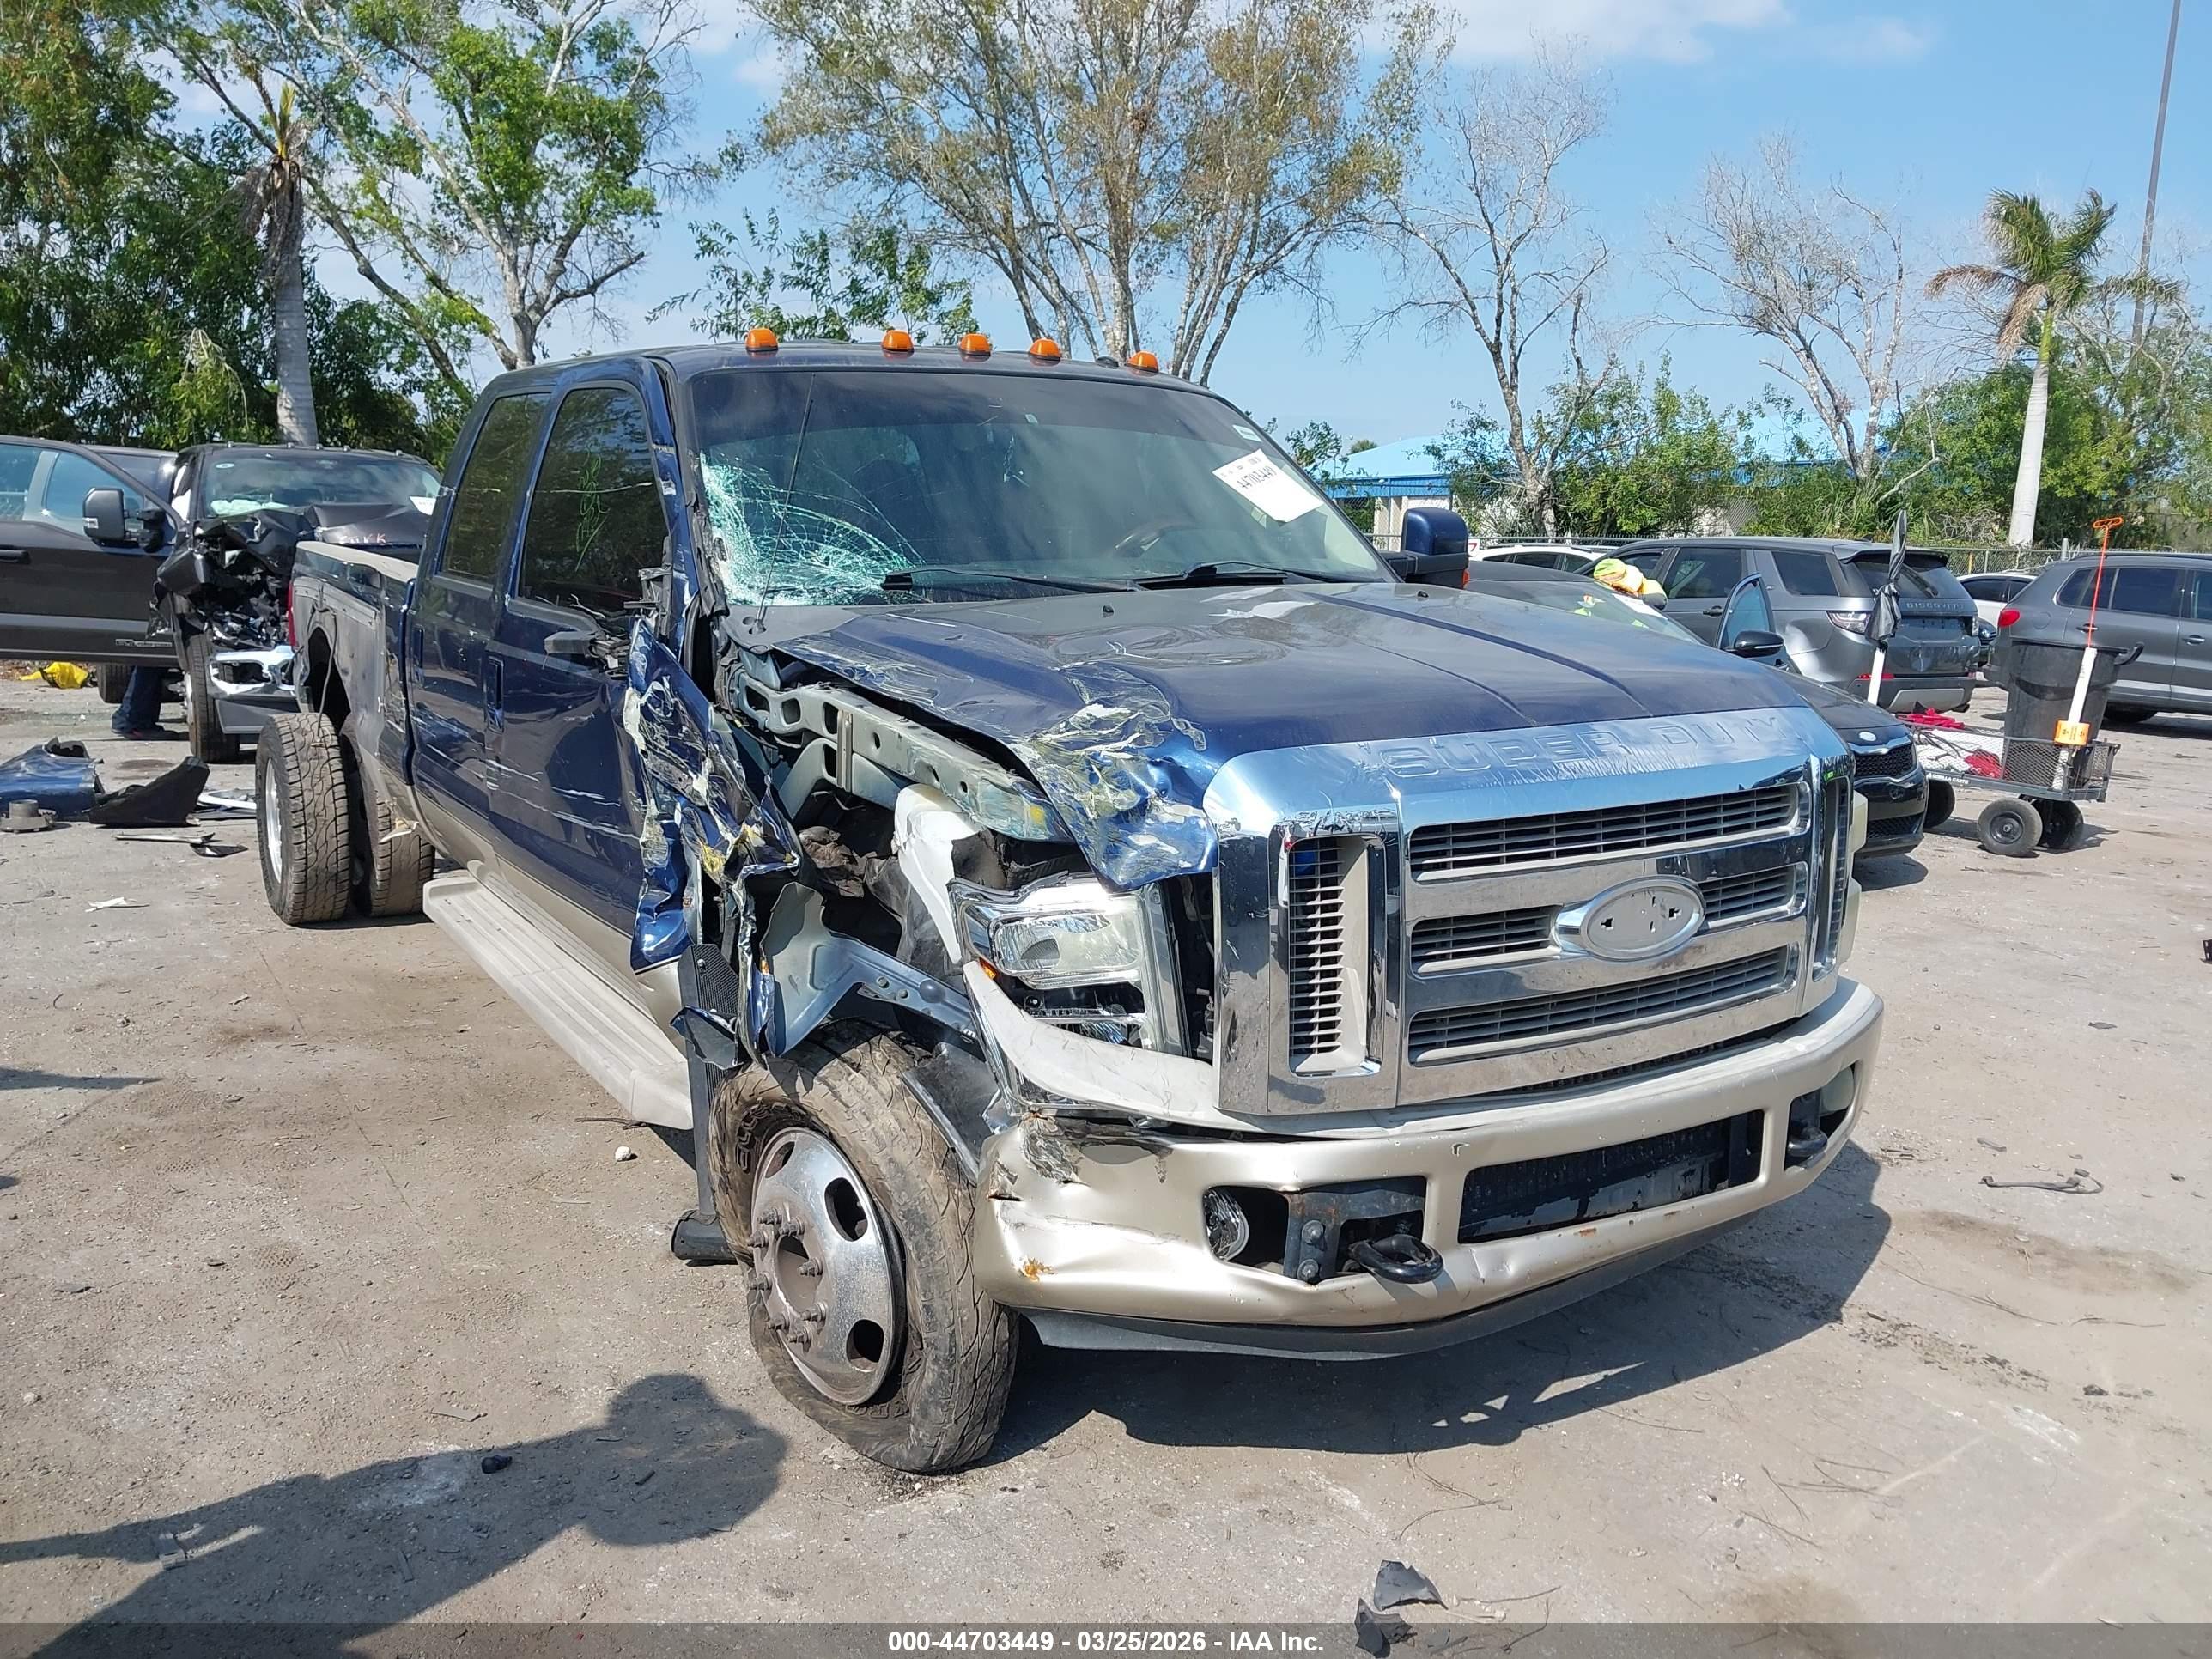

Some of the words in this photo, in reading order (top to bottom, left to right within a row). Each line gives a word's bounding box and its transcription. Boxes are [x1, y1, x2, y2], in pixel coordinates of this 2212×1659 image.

[1237, 465, 1278, 489] 44703449
[1379, 731, 1633, 779] SUPER
[1648, 716, 1788, 749] DUTY
